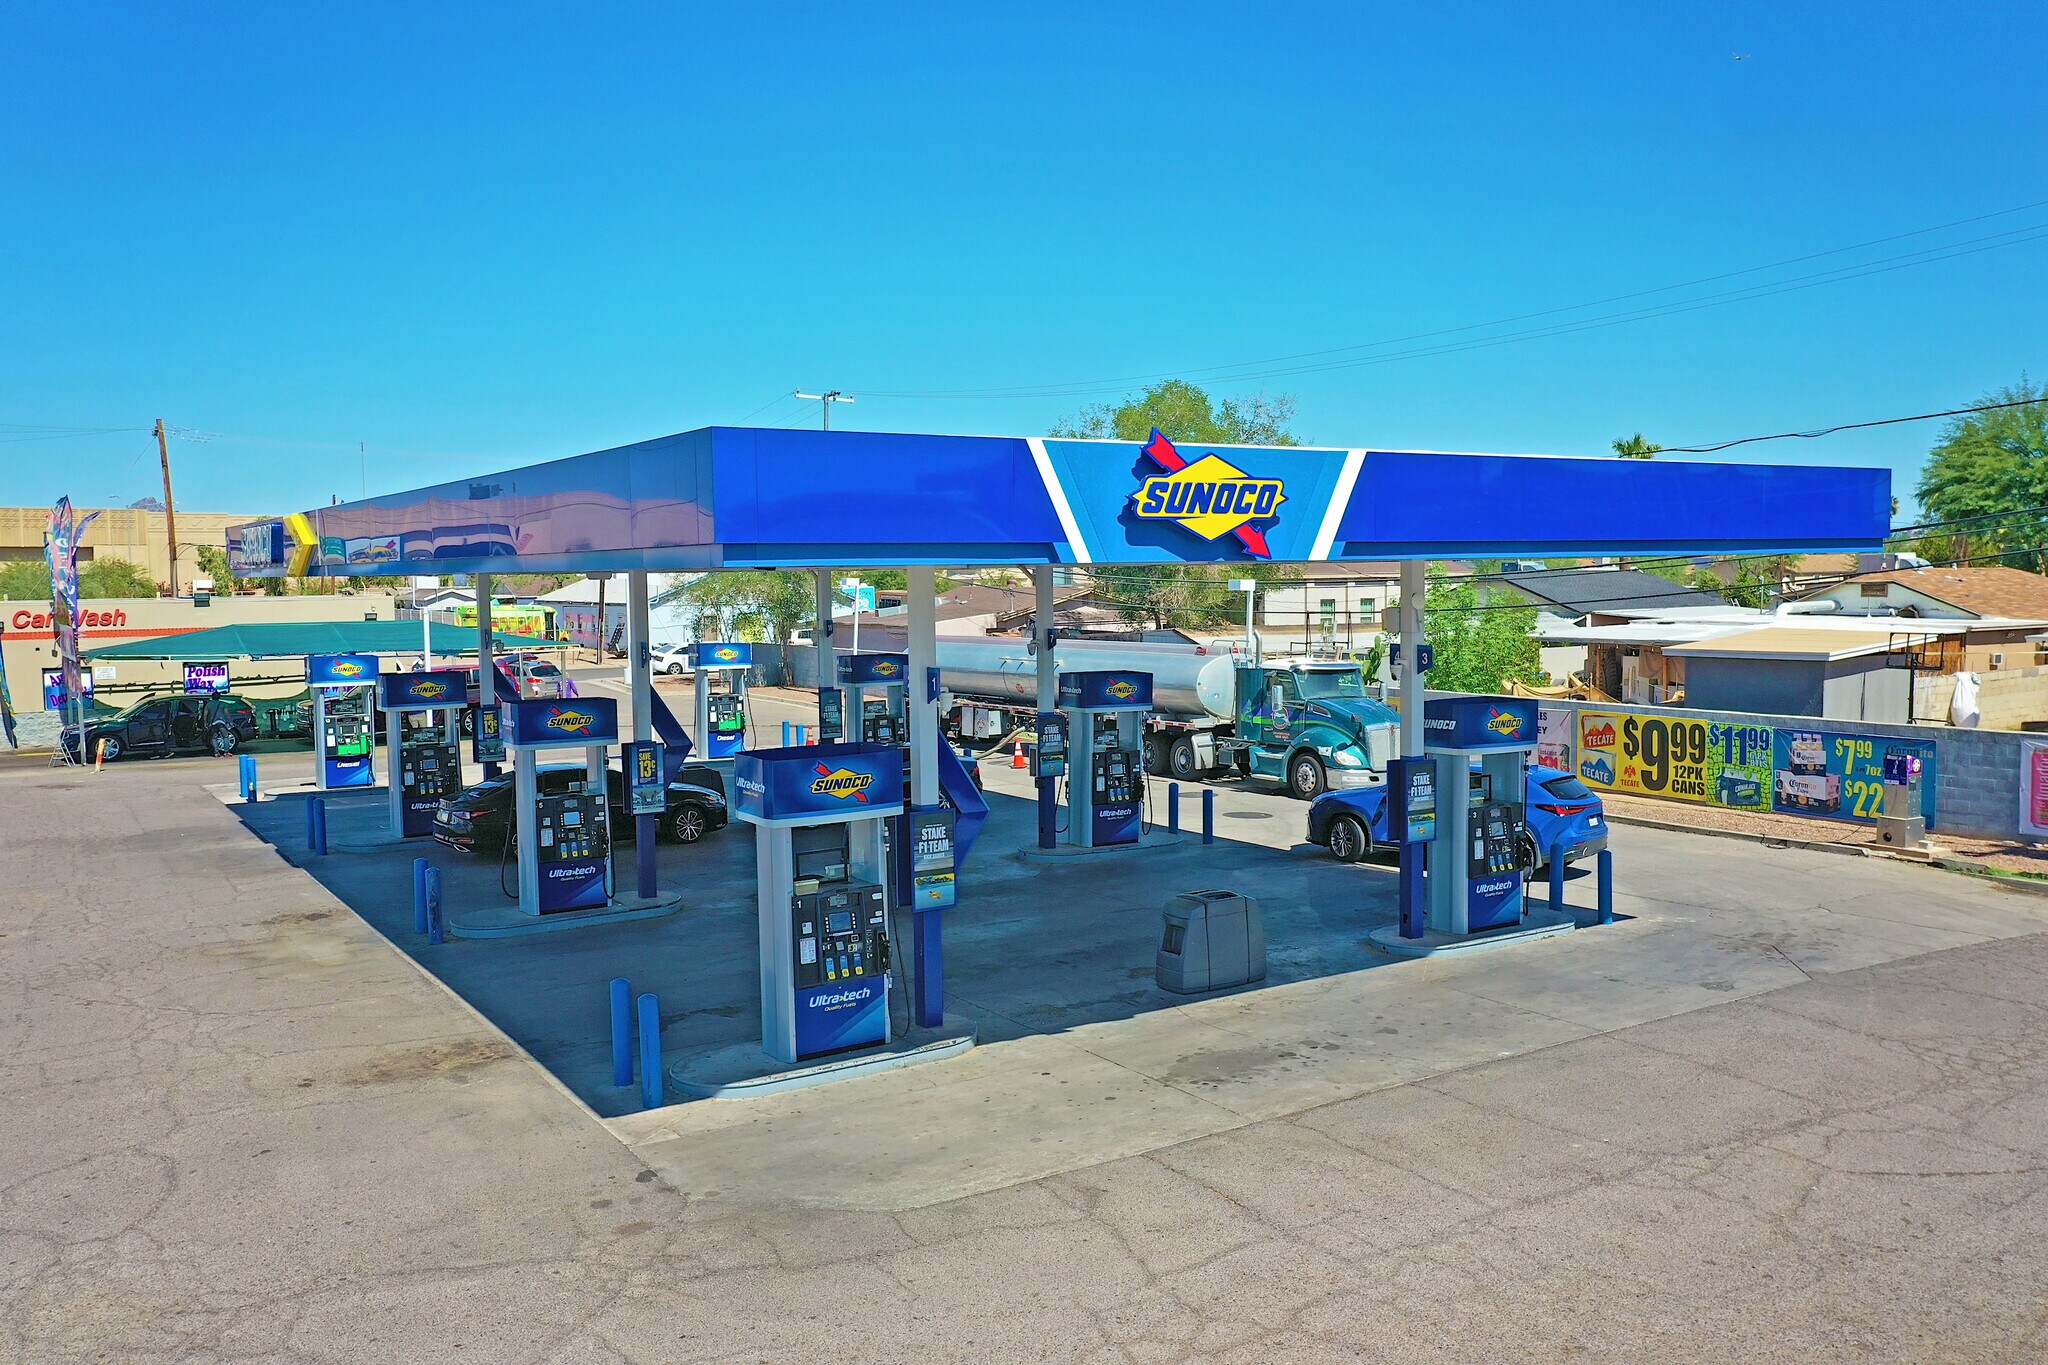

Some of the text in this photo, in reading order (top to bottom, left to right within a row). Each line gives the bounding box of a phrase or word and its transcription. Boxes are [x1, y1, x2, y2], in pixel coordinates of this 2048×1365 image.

[1141, 481, 1279, 515] SUNOCO
[12, 609, 55, 629] Car
[1422, 652, 1428, 664] 3
[187, 663, 226, 677] Polish
[187, 678, 215, 689] Wax
[410, 685, 446, 694] SUNOCO
[931, 677, 936, 691] 1
[1108, 686, 1136, 694] SUNOCO
[549, 715, 592, 727] SUNOCO
[1423, 719, 1457, 730] UNOCO
[1488, 719, 1522, 730] SUNOCO
[1587, 735, 1614, 746] TECATE
[638, 752, 652, 761] SAVE
[1582, 766, 1609, 783] TECATE
[1673, 765, 1703, 781] 12PK
[814, 775, 870, 792] SUNOCO
[1413, 774, 1430, 786] STAKE
[1620, 778, 1640, 788] TECATE
[1418, 785, 1432, 796] TEAM
[1671, 779, 1705, 796] CANS
[1472, 811, 1477, 819] 3
[921, 826, 947, 841] STAKE
[918, 839, 949, 854] F1 TEAM
[797, 900, 802, 909] 1
[824, 1003, 843, 1012] Quality
